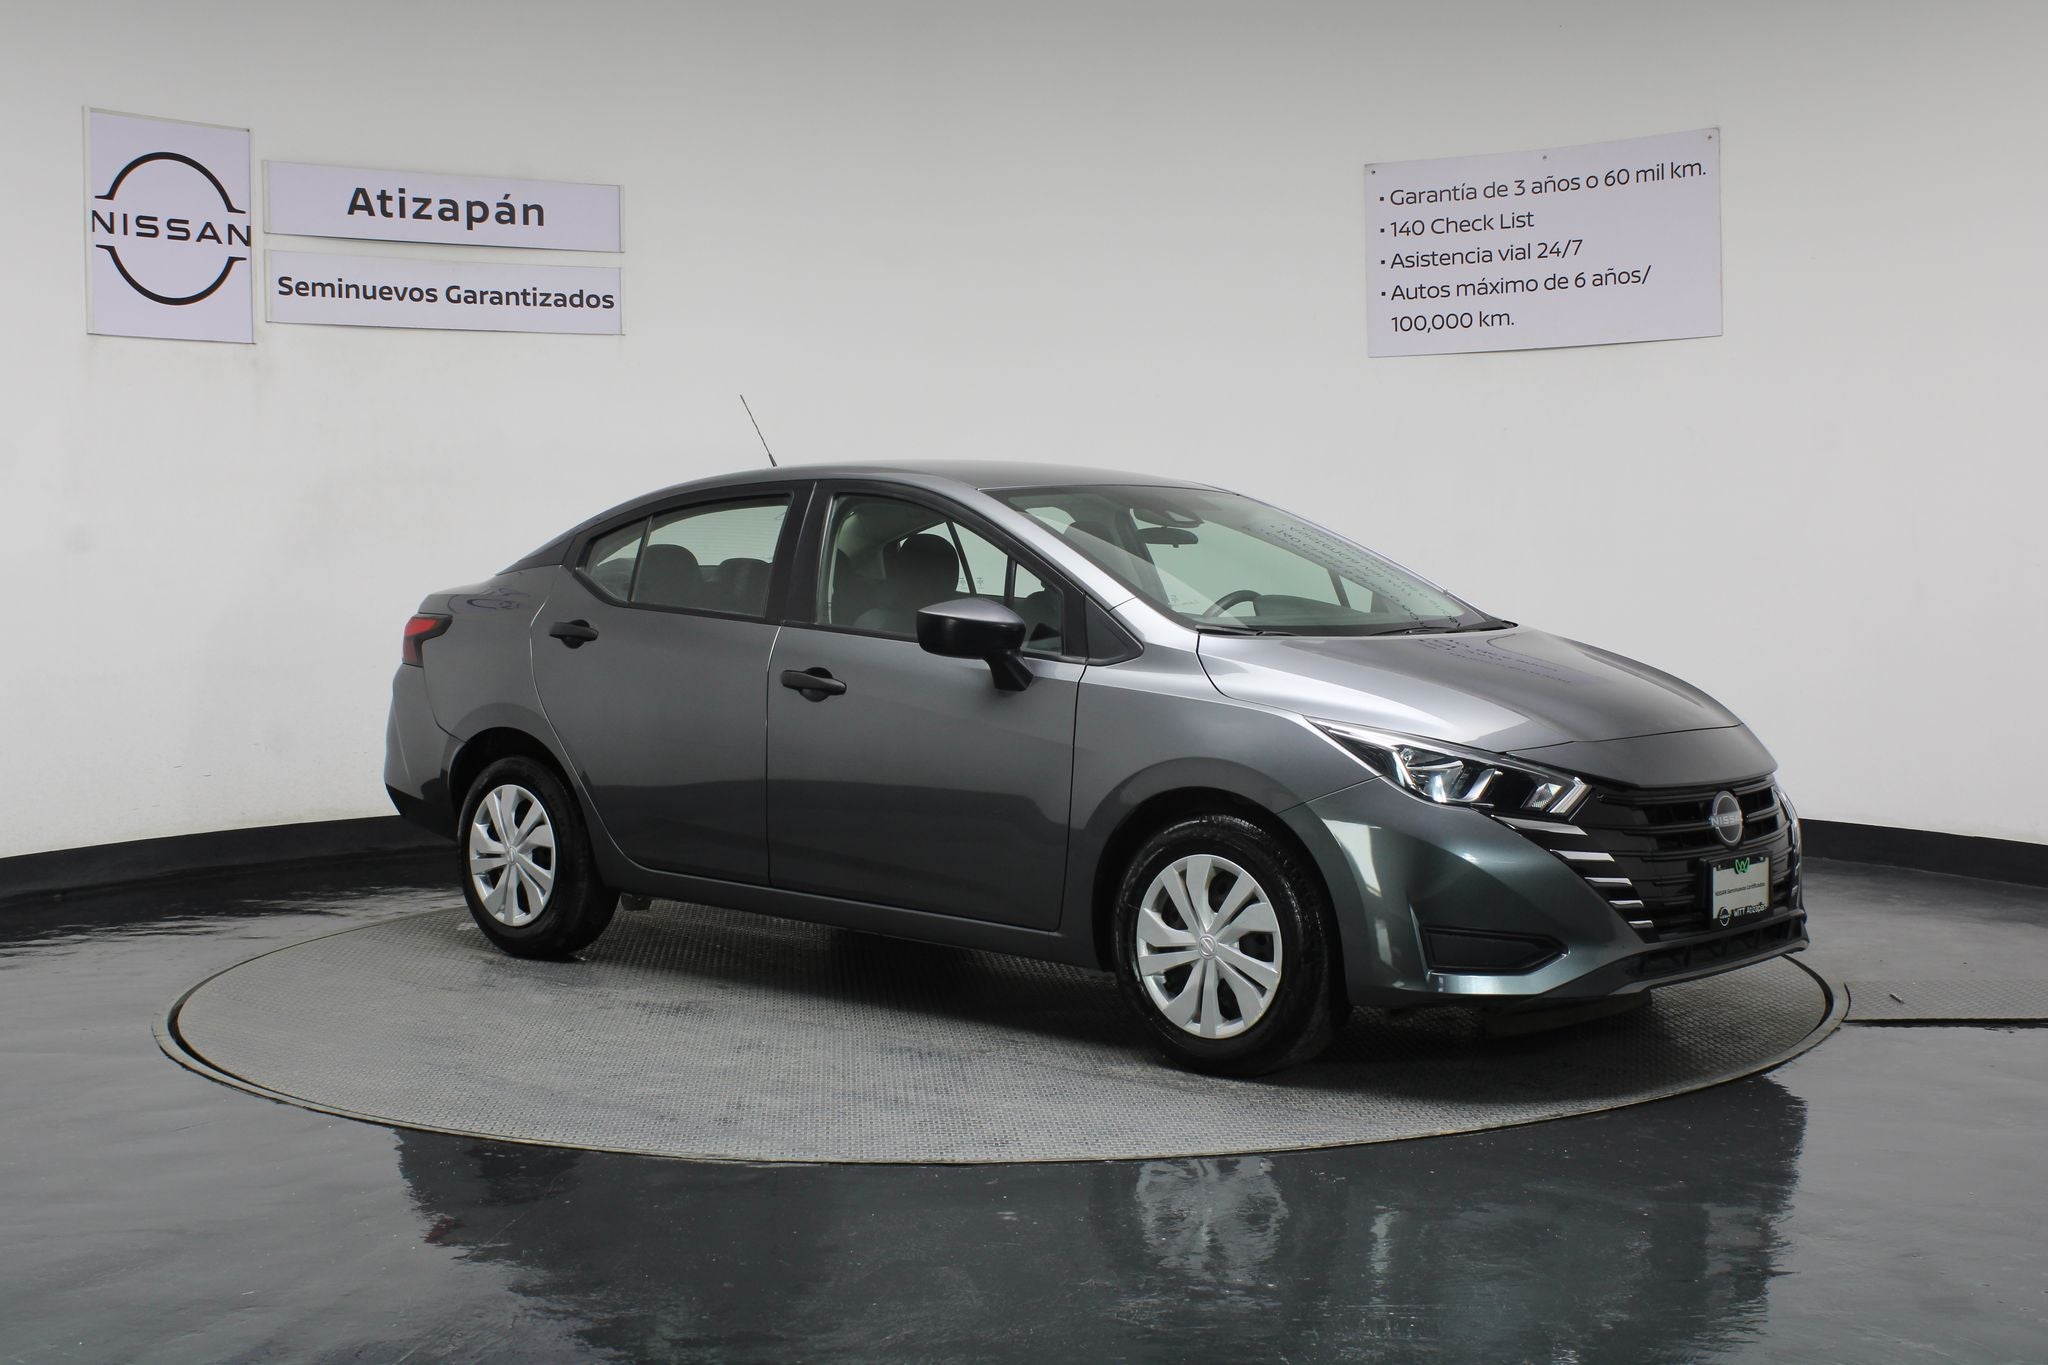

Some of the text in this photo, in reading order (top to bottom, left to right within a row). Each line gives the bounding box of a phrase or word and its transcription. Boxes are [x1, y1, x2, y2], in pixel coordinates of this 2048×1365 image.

[1389, 161, 1707, 206] Garantía de 3 años o 60 mil km.
[347, 187, 544, 231] Atizapán
[1389, 211, 1535, 238] 140 Check List
[91, 209, 252, 247] NISSAN
[1390, 239, 1584, 270] Asistencia vial 24/7
[278, 276, 615, 310] Seminuevos Garantizados
[1390, 264, 1652, 301] Autos máximo de 6 años/
[1391, 310, 1515, 334] 100,000 km.
[1711, 814, 1741, 827] NISS
